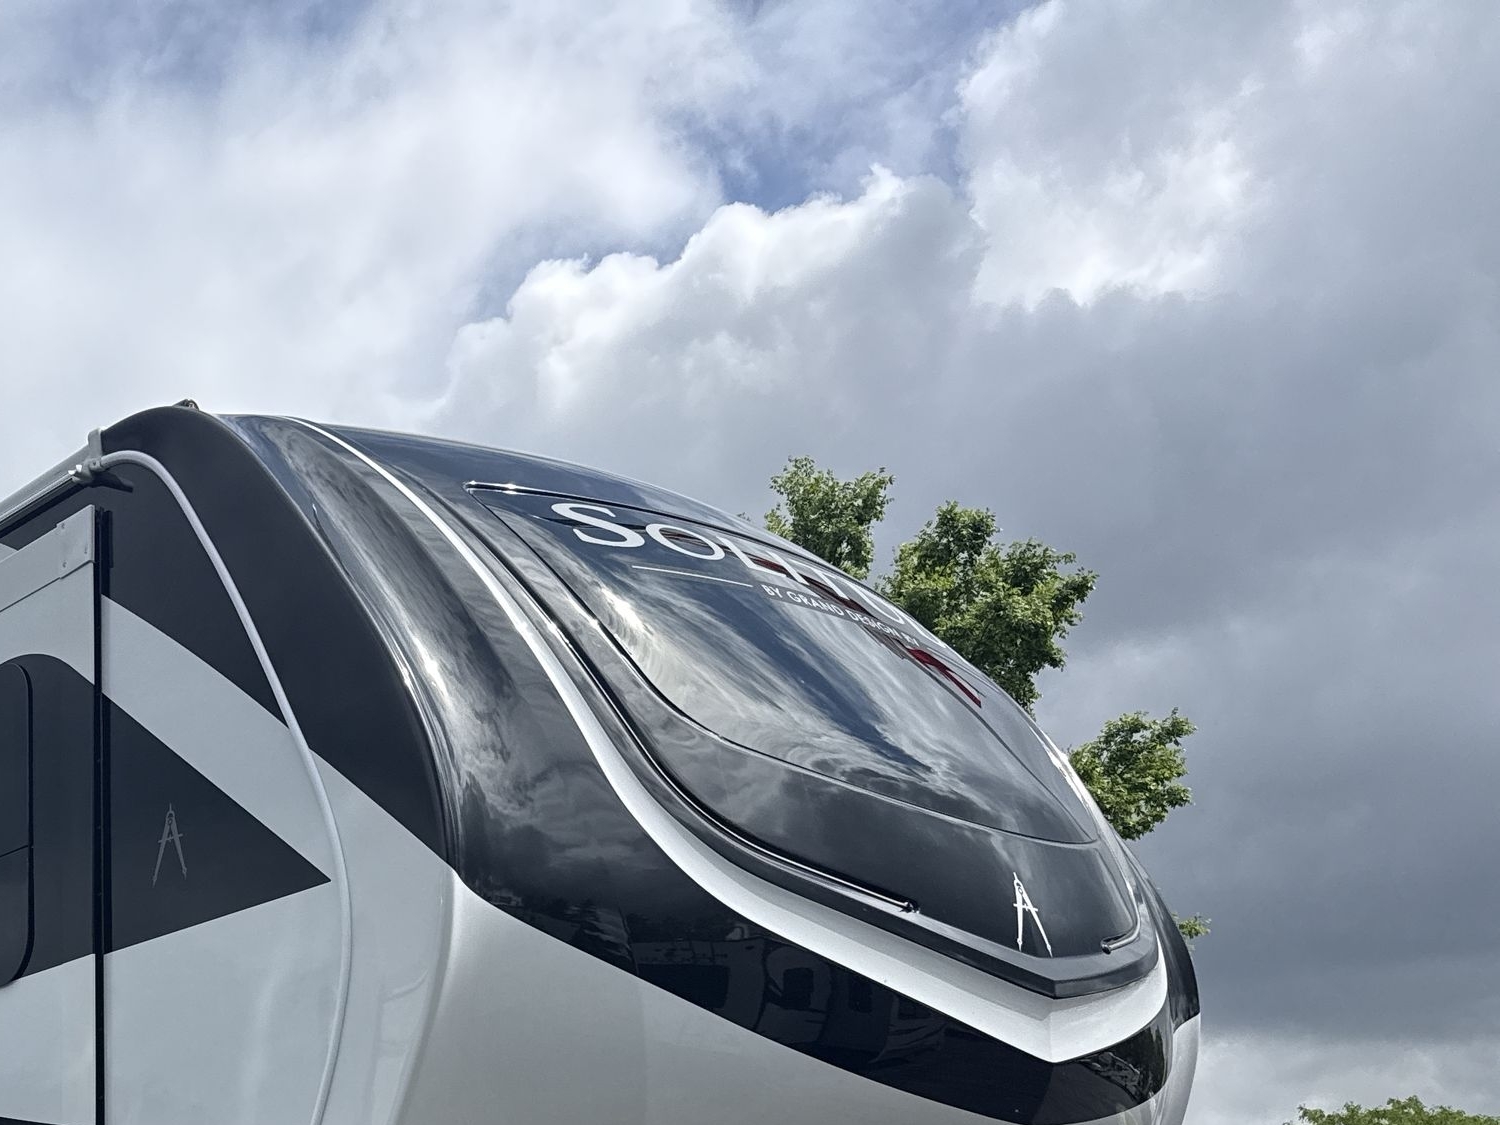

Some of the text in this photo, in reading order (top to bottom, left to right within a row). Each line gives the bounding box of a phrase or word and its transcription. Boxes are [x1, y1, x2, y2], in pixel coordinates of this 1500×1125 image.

[761, 584, 783, 598] BY
[786, 590, 845, 616] GRAND
[844, 609, 903, 639] DESIGN
